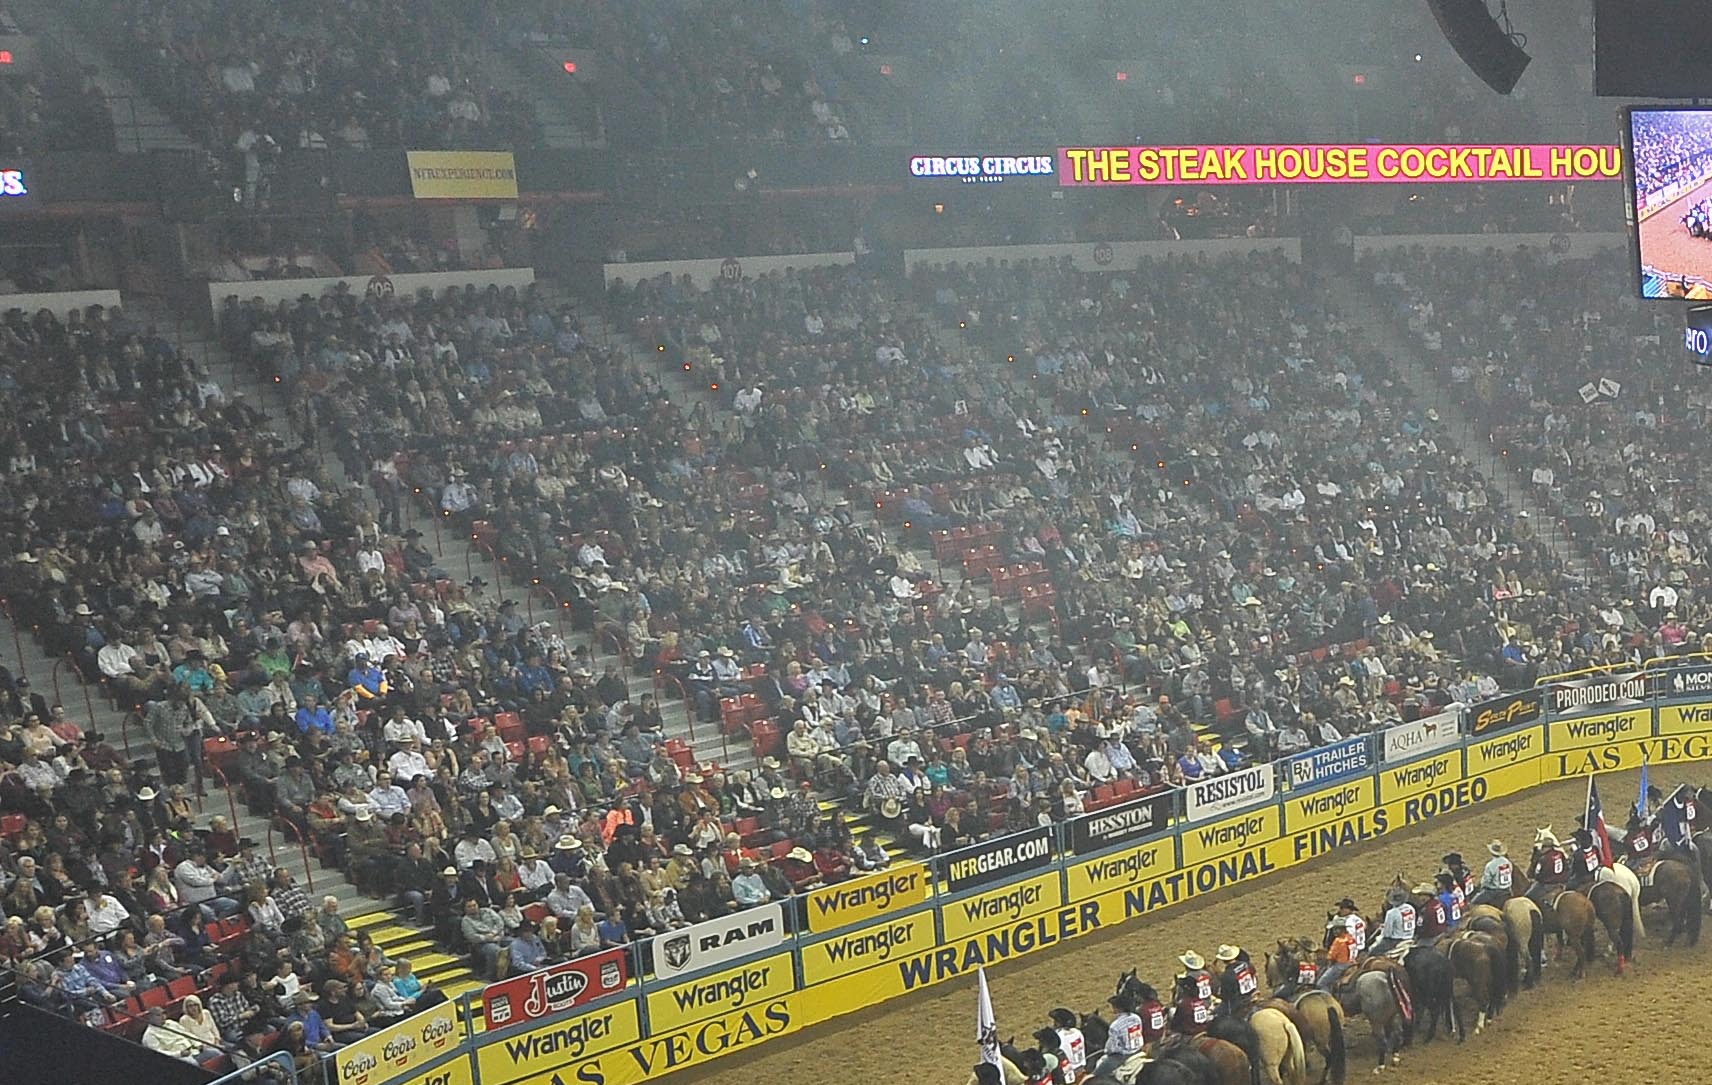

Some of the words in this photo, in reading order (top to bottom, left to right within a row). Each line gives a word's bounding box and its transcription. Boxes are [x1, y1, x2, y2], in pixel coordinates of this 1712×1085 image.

[910, 157, 979, 175] CIRCUS
[982, 157, 1053, 174] CIRCUS
[1067, 150, 1130, 181] THE
[1139, 149, 1247, 180] STEAK
[1256, 148, 1368, 178] HOUSE
[1377, 147, 1543, 177] COCKTAIL
[1551, 148, 1622, 177] HOU
[1557, 680, 1646, 708] PRORODEO.COM
[1390, 730, 1424, 752] AQHA
[1567, 714, 1636, 741] Wrangler
[1314, 743, 1365, 766] TRAILER
[1480, 733, 1532, 761] Wrangler
[1558, 746, 1621, 777] LAS
[1316, 755, 1368, 780] HITCHES
[1393, 757, 1450, 793] Wrangler
[1195, 770, 1265, 808] RESISTOL
[1300, 784, 1361, 818] Wrangler
[1088, 804, 1153, 836] HESSTON
[1199, 815, 1264, 850] Wrangler
[950, 836, 1049, 882] NFRGEAR.COM
[1086, 847, 1158, 885] Wrangler
[815, 871, 918, 915] Wrangler
[900, 900, 1102, 990] WRANGLER
[1125, 850, 1275, 918] NATIONAL
[1294, 809, 1388, 862] FINALS
[1405, 776, 1488, 827] RODEO
[963, 883, 1042, 923] Wrangler
[700, 918, 774, 952] RAM
[825, 921, 914, 964] Wrangler
[525, 971, 584, 1018] Justin
[673, 966, 770, 1013] Wrangler
[422, 1017, 453, 1044] Coors
[505, 1013, 613, 1065] Wrangler
[628, 1001, 791, 1077] VEGAS
[382, 1035, 417, 1061] Coors
[342, 1054, 378, 1081] Coors
